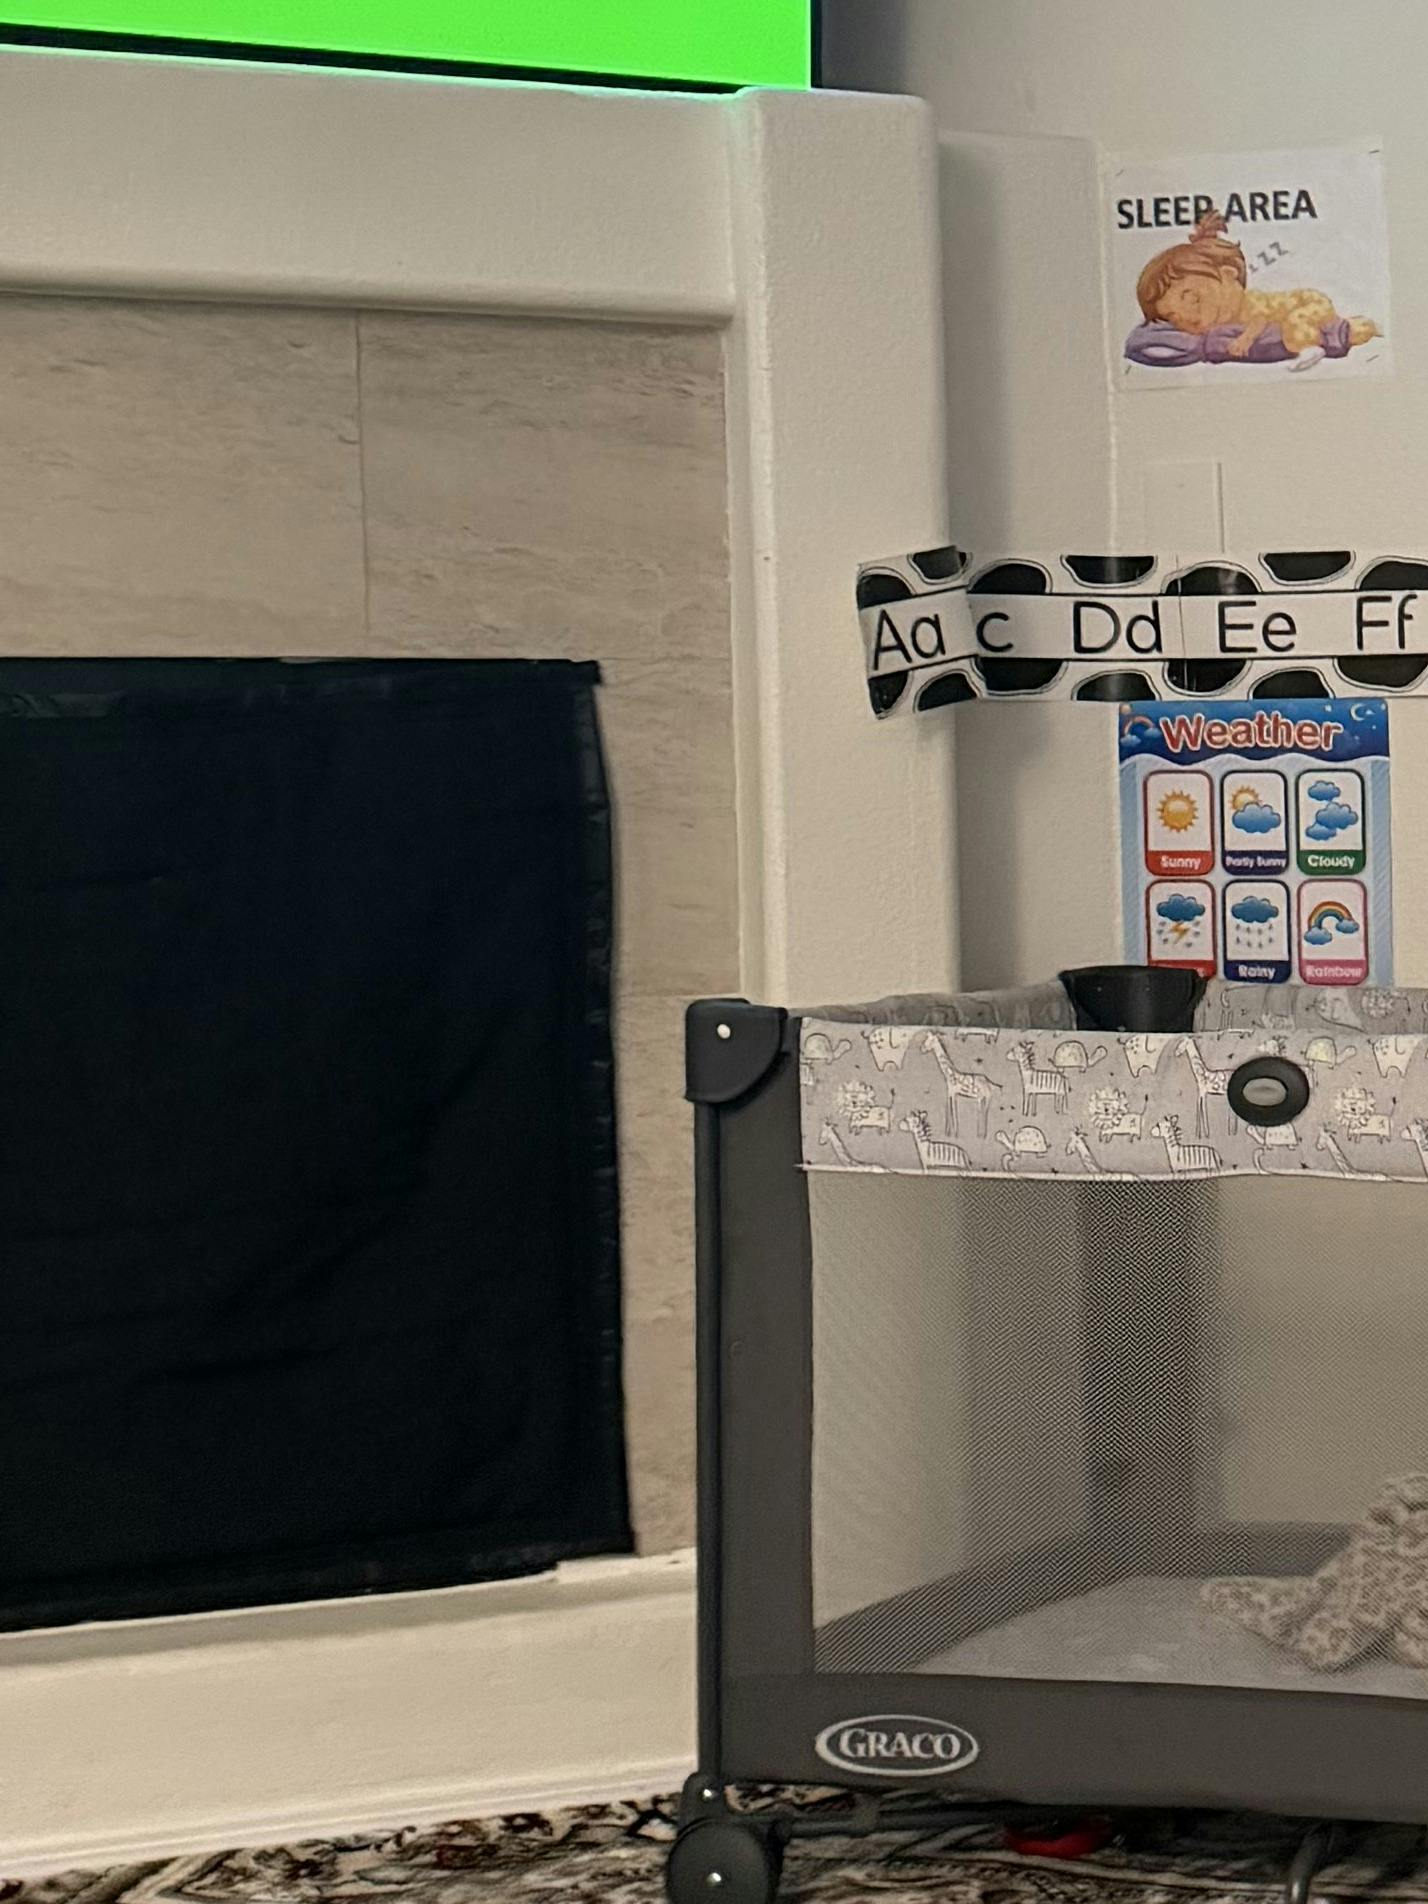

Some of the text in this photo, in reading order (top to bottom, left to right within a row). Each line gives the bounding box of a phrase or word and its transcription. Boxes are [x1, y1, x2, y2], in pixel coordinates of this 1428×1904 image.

[1116, 189, 1318, 229] SLEEP AREA
[873, 609, 946, 671] Aa
[1073, 600, 1163, 654] Dd
[1217, 600, 1297, 653] Ee
[1356, 594, 1417, 651] Ff
[1159, 710, 1344, 753] Weather
[1160, 855, 1201, 870] Sunny
[1307, 855, 1355, 869] Cloudy
[1238, 965, 1275, 979] Rainy
[839, 1728, 961, 1760] GRACO
